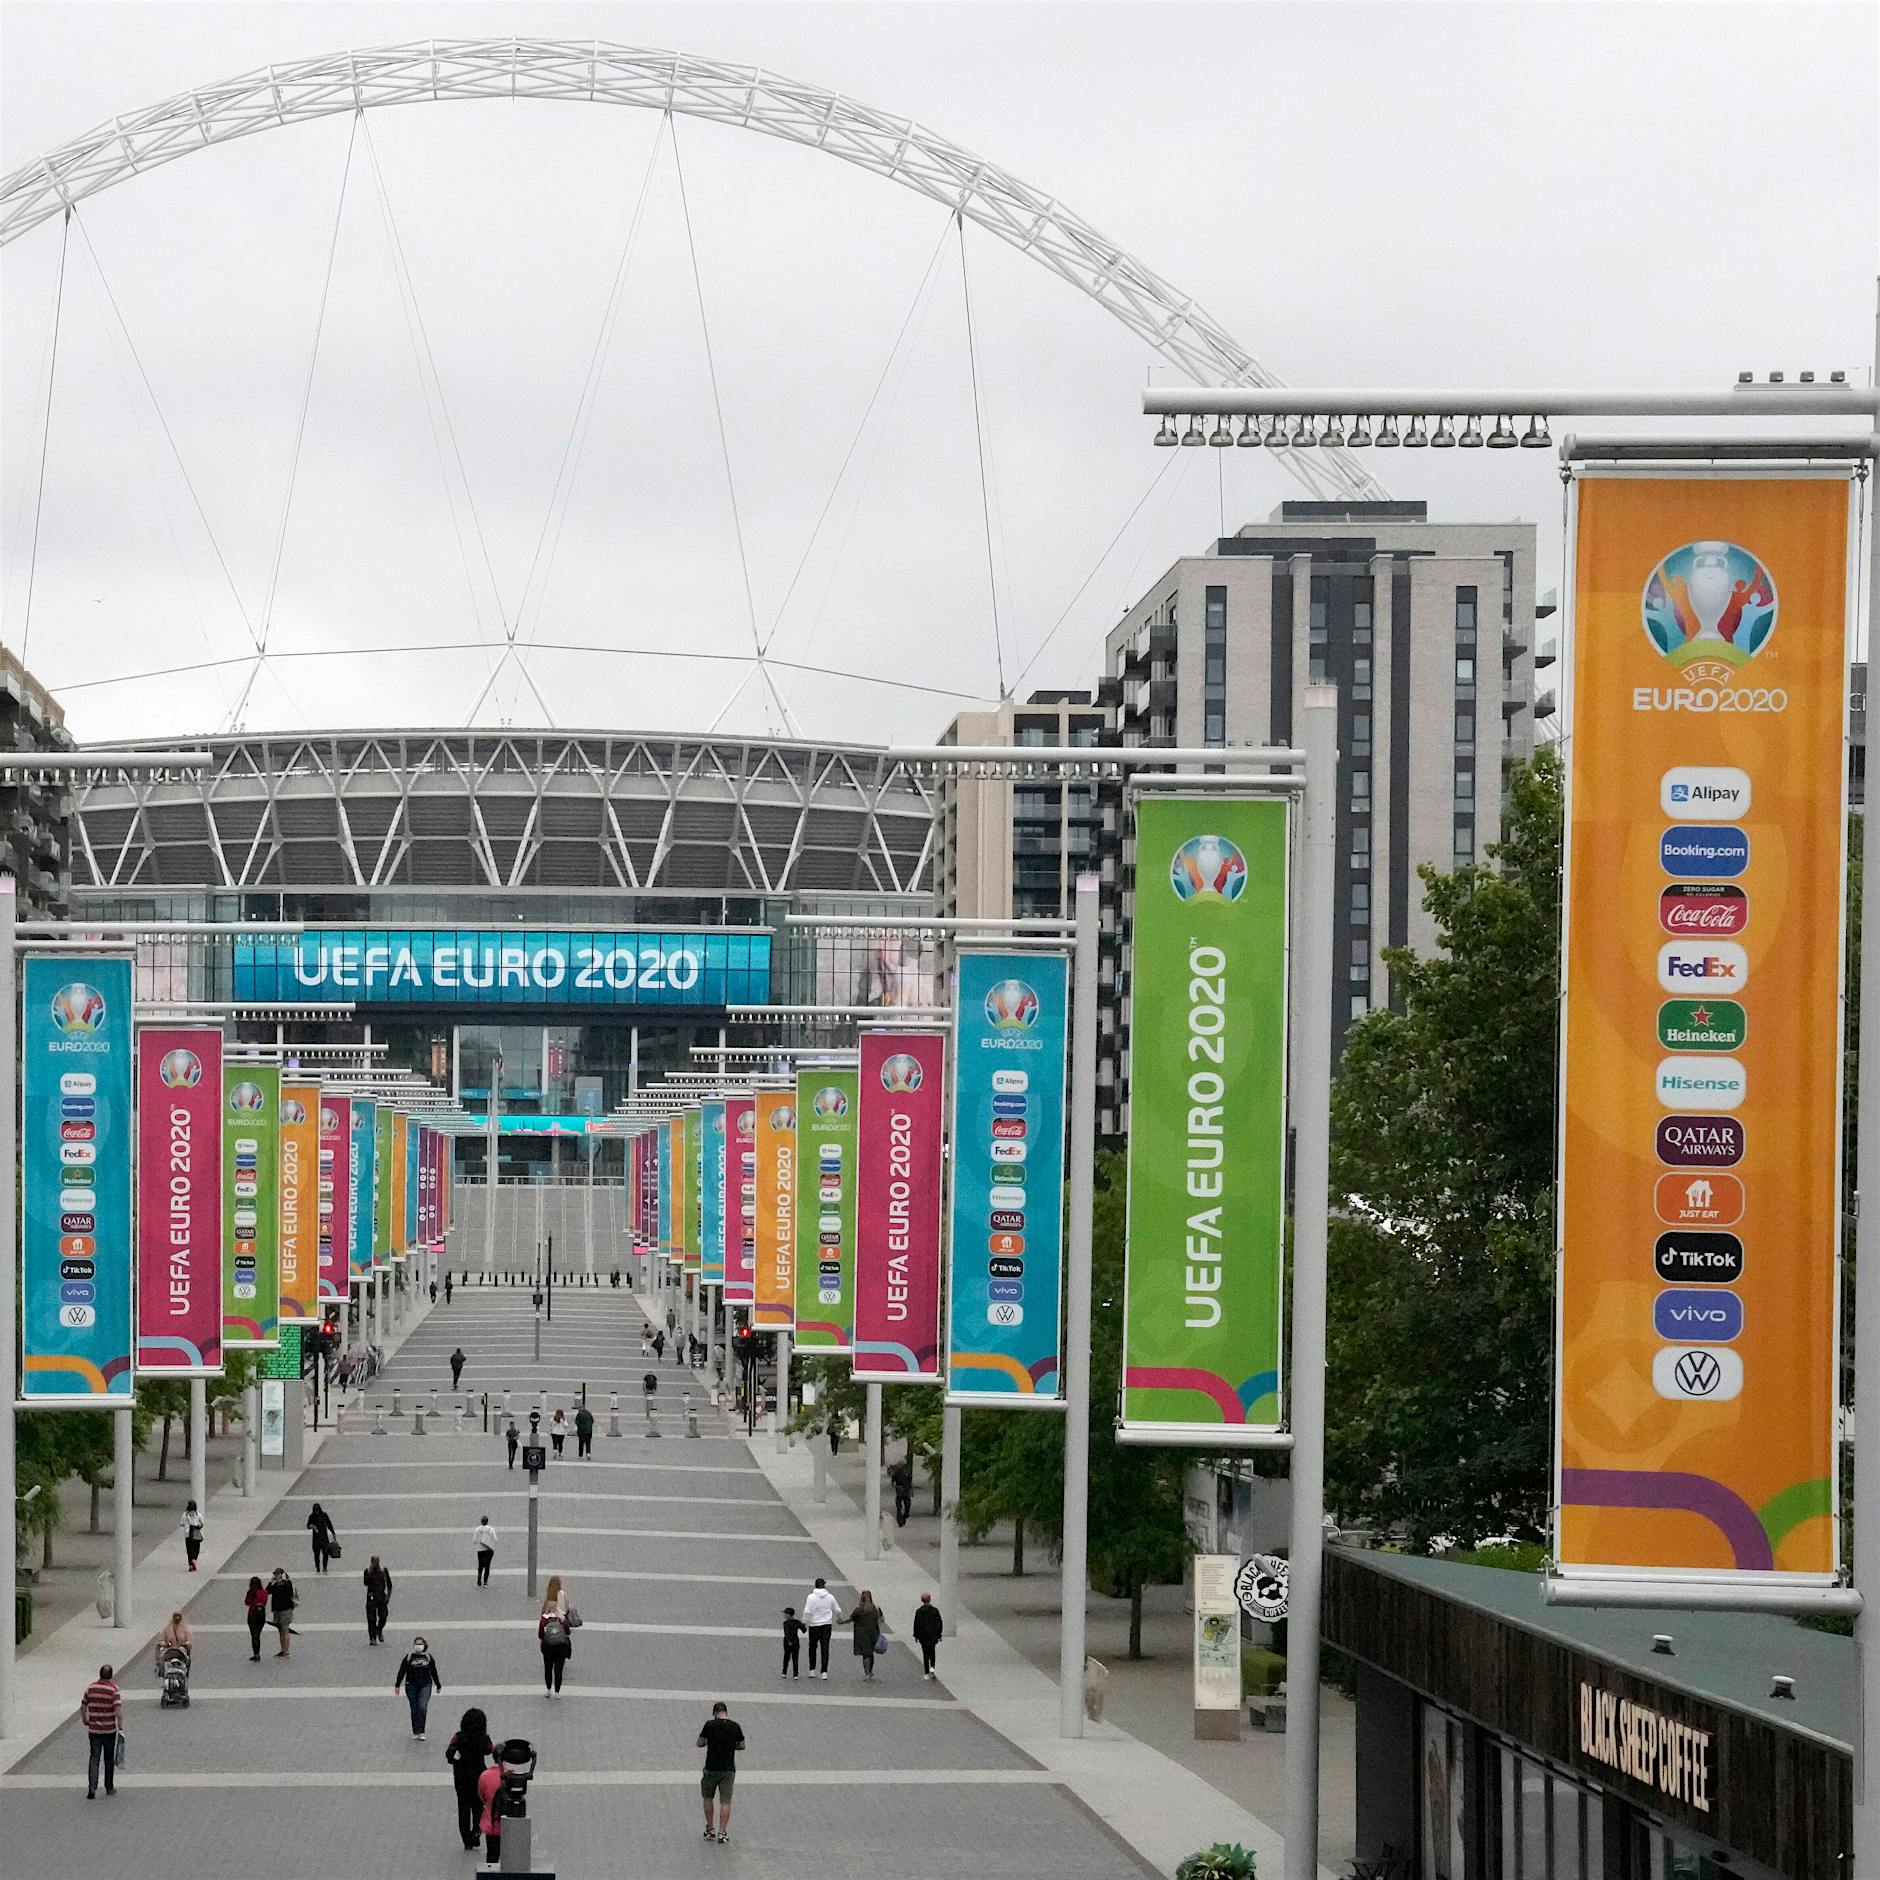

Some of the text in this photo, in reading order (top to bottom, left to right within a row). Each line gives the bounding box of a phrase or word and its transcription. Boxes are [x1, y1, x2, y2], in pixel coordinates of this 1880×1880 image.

[1684, 665, 1731, 684] UEFA
[1632, 687, 1788, 712] EURO2020
[1692, 786, 1740, 802] Alipay
[1664, 844, 1745, 859] Booking.com
[293, 947, 699, 990] UEFA EURO 2020
[1668, 956, 1737, 978] FedEx
[1667, 1029, 1736, 1043] Heineken
[1662, 1076, 1740, 1090] Hisense
[1187, 1072, 1225, 1198] EURO
[1664, 1126, 1736, 1147] QATAR
[64, 1149, 91, 1158] FedEx
[995, 1146, 1023, 1156] FedEx
[1681, 1144, 1736, 1156] AIRWAYS
[170, 1176, 191, 1245] EURO
[282, 1140, 298, 1283] UEFA EURO 2020
[776, 1147, 792, 1290] UEFA EURO 2020
[888, 1181, 911, 1250] EURO
[993, 1214, 1022, 1224] QATAR
[1679, 1209, 1720, 1219] JUST EAT
[63, 1216, 92, 1226] QATAR
[1184, 1206, 1223, 1328] UEFA
[1680, 1251, 1737, 1268] TikTok
[70, 1266, 93, 1274] TikTok
[998, 1264, 1022, 1273] TikTok
[169, 1249, 190, 1316] UEFA
[887, 1254, 909, 1321] UEFA
[993, 1287, 1018, 1295] vivo
[66, 1288, 89, 1296] vivo
[1670, 1305, 1727, 1322] vivo
[1580, 1682, 1710, 1813] BLACK SHEEP COFFEE
